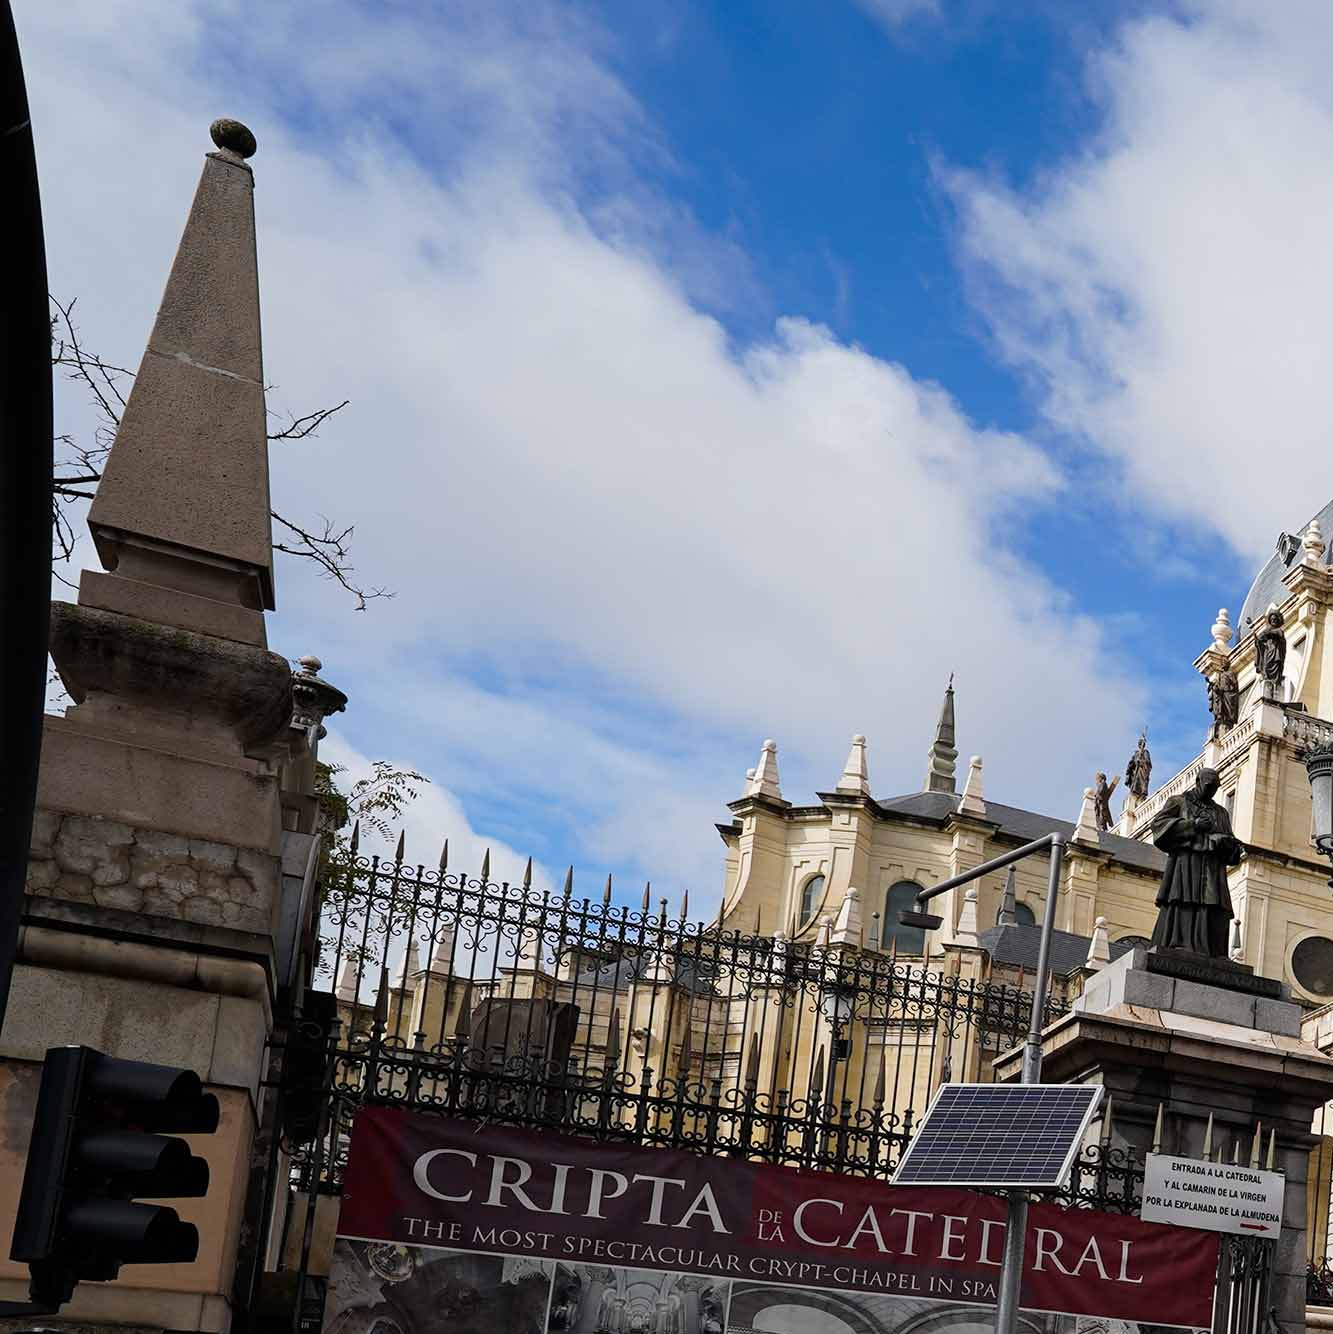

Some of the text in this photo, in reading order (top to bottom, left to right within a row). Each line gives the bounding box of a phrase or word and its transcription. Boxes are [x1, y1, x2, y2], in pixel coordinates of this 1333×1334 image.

[1171, 1162, 1262, 1184] ENTRADA A LA CATEDRAL
[413, 1149, 733, 1234] CRIPTA
[1164, 1180, 1267, 1203] Y AL CAMARIN DE LA VIRGEN
[759, 1208, 782, 1224] DE
[1145, 1195, 1280, 1223] POR LA EXPLANADA DE LA ALMUDENA
[758, 1224, 785, 1242] LA
[402, 1217, 463, 1241] THE
[472, 1225, 555, 1251] MOST
[563, 1236, 743, 1272] SPECTACULAR
[749, 1257, 920, 1291] CRYPT-CHAPEL
[928, 1277, 954, 1295] IN
